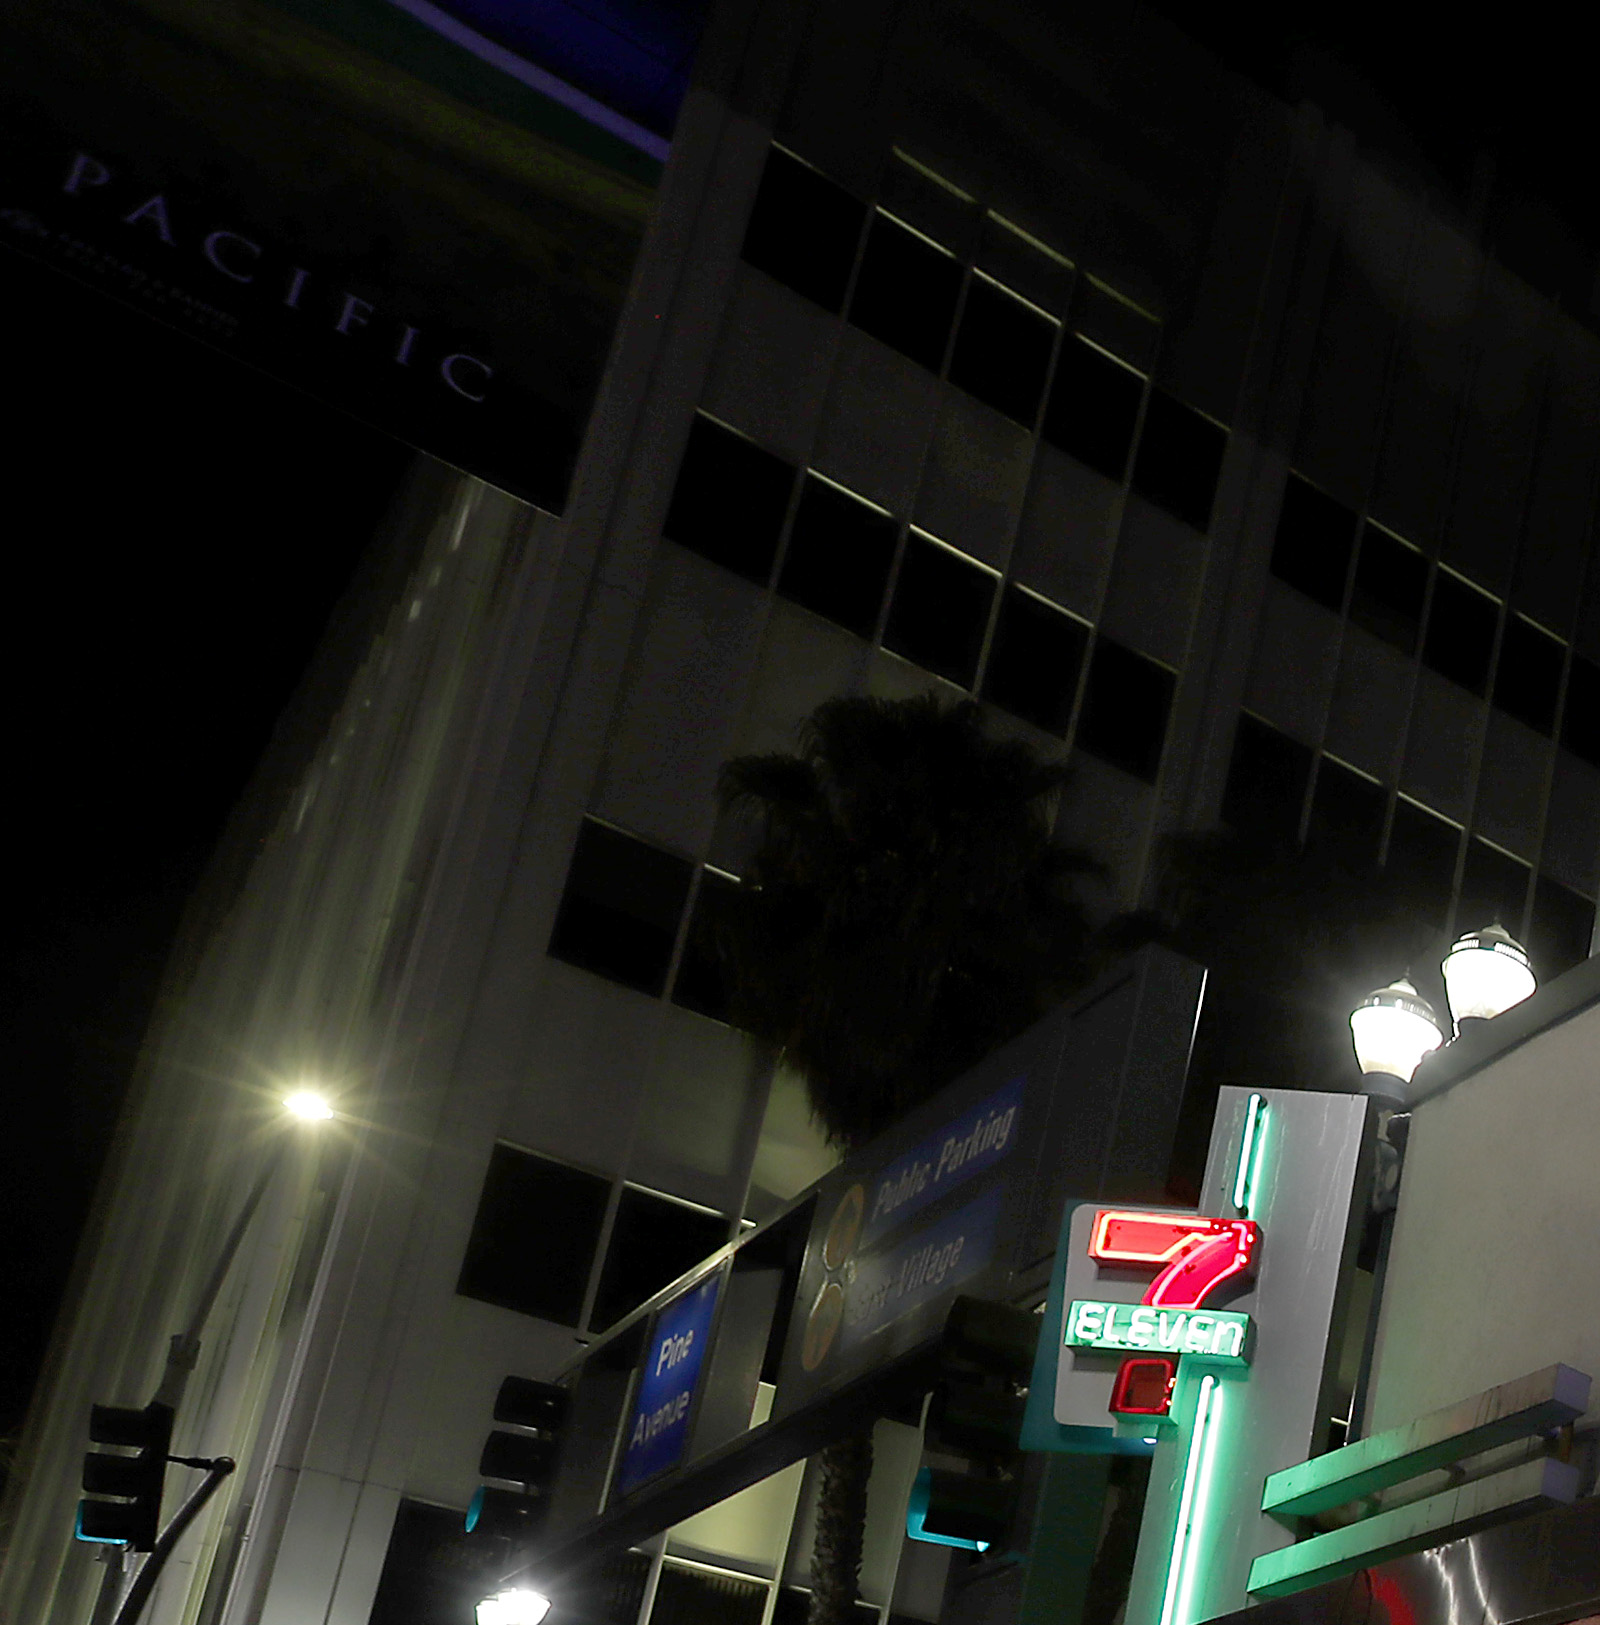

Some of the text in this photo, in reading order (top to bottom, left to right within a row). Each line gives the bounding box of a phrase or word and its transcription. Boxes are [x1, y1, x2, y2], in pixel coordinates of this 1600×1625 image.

[61, 150, 496, 404] PACIFIC
[871, 1105, 1017, 1223] Public Parking
[897, 1235, 965, 1298] Village
[655, 1328, 695, 1378] Pine
[1089, 1209, 1259, 1424] 7
[628, 1390, 690, 1452] Avenue
